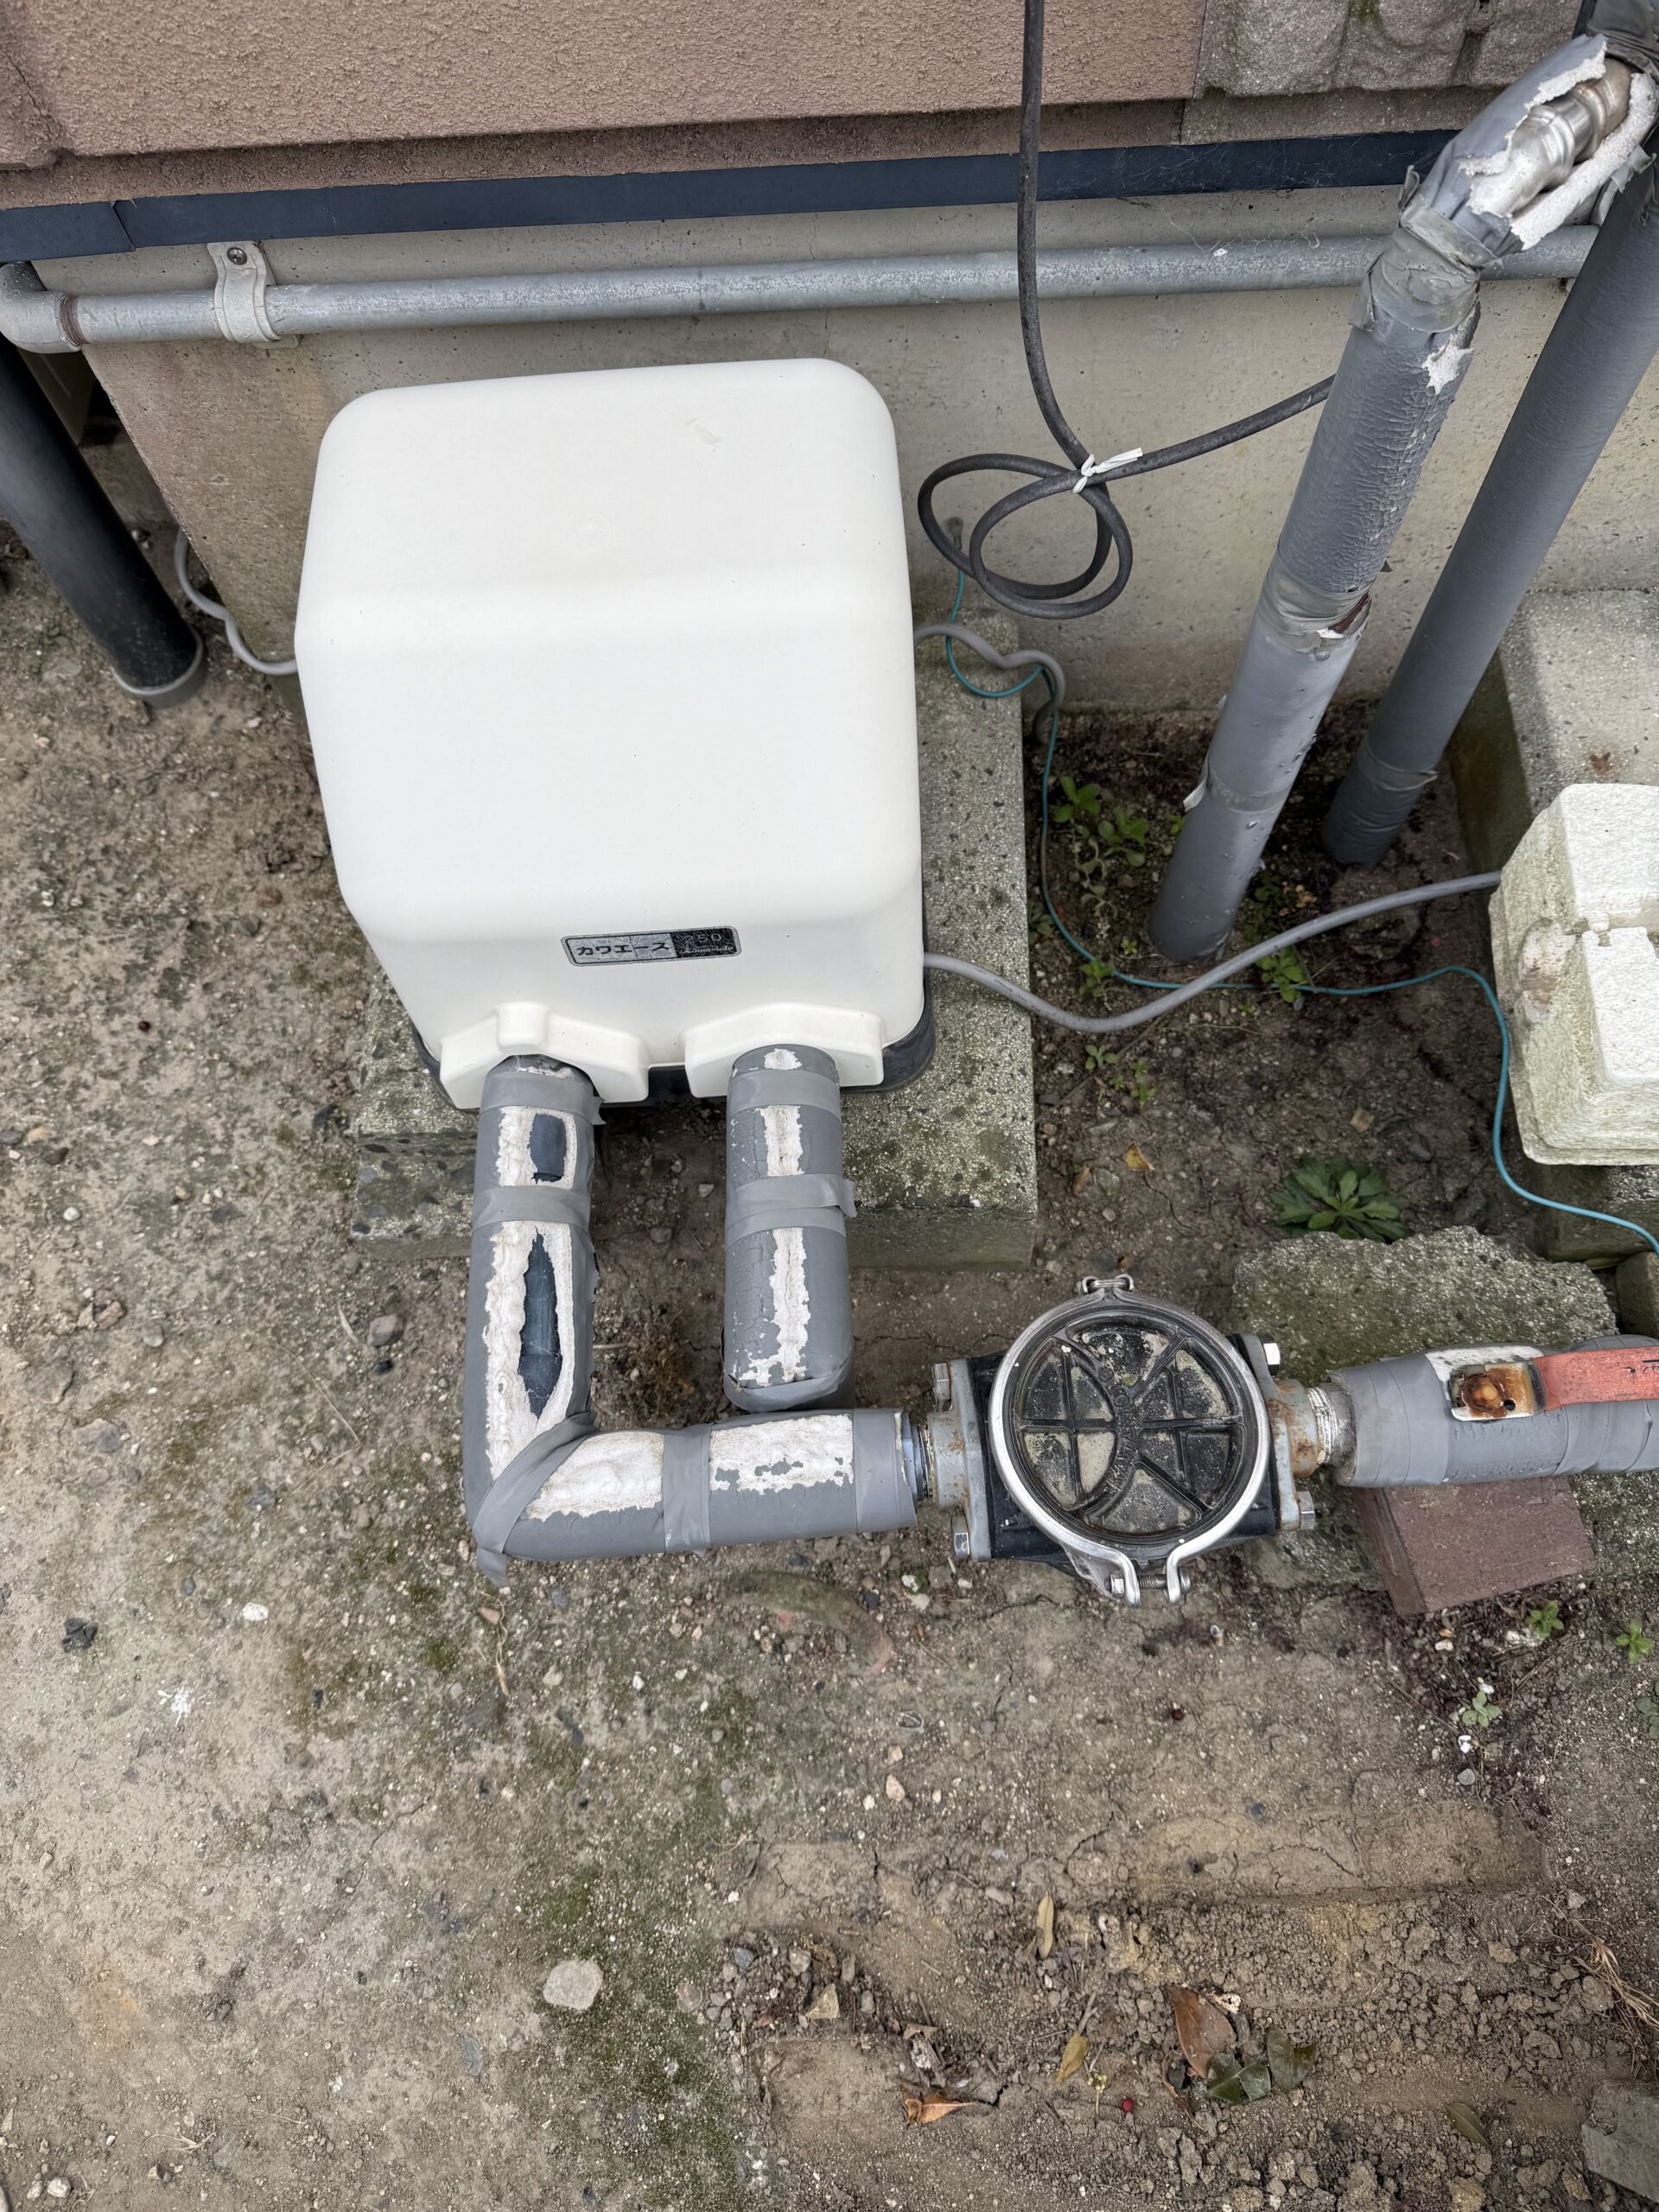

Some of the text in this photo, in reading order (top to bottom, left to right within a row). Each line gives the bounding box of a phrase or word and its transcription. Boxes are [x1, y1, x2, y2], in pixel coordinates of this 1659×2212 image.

[684, 933, 721, 944] 250
[576, 942, 670, 956] カワエース
